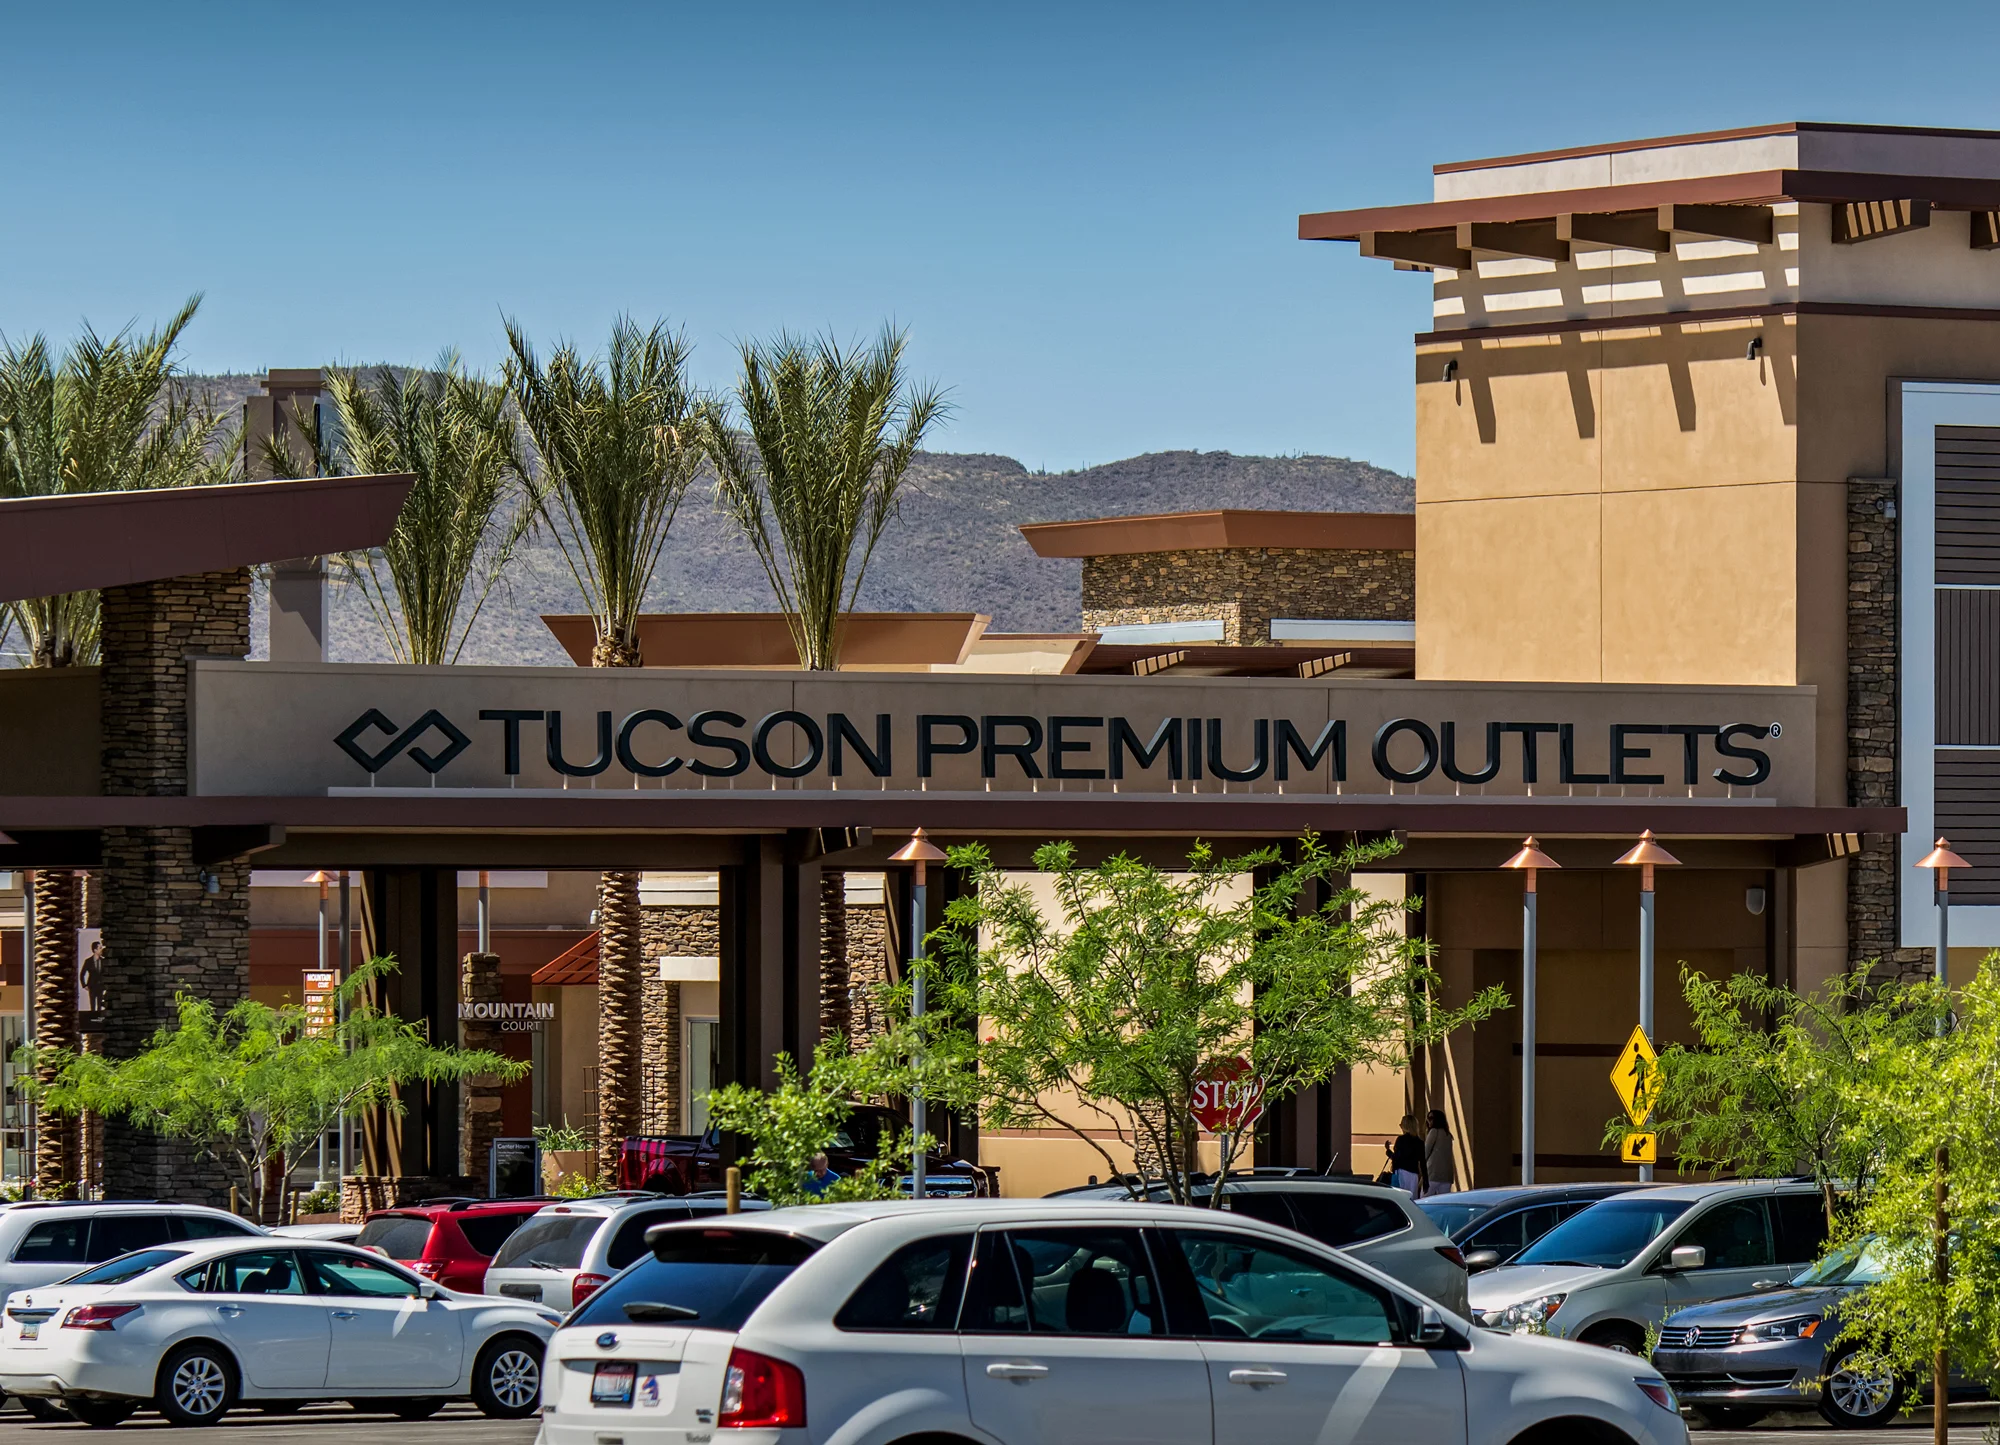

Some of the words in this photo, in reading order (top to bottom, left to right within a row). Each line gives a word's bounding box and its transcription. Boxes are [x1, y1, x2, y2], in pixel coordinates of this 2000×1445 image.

[479, 708, 891, 778] TUCSON
[916, 713, 1346, 783] PREMIUM
[458, 1002, 555, 1018] MOUNTAIN
[501, 1021, 541, 1031] COURT
